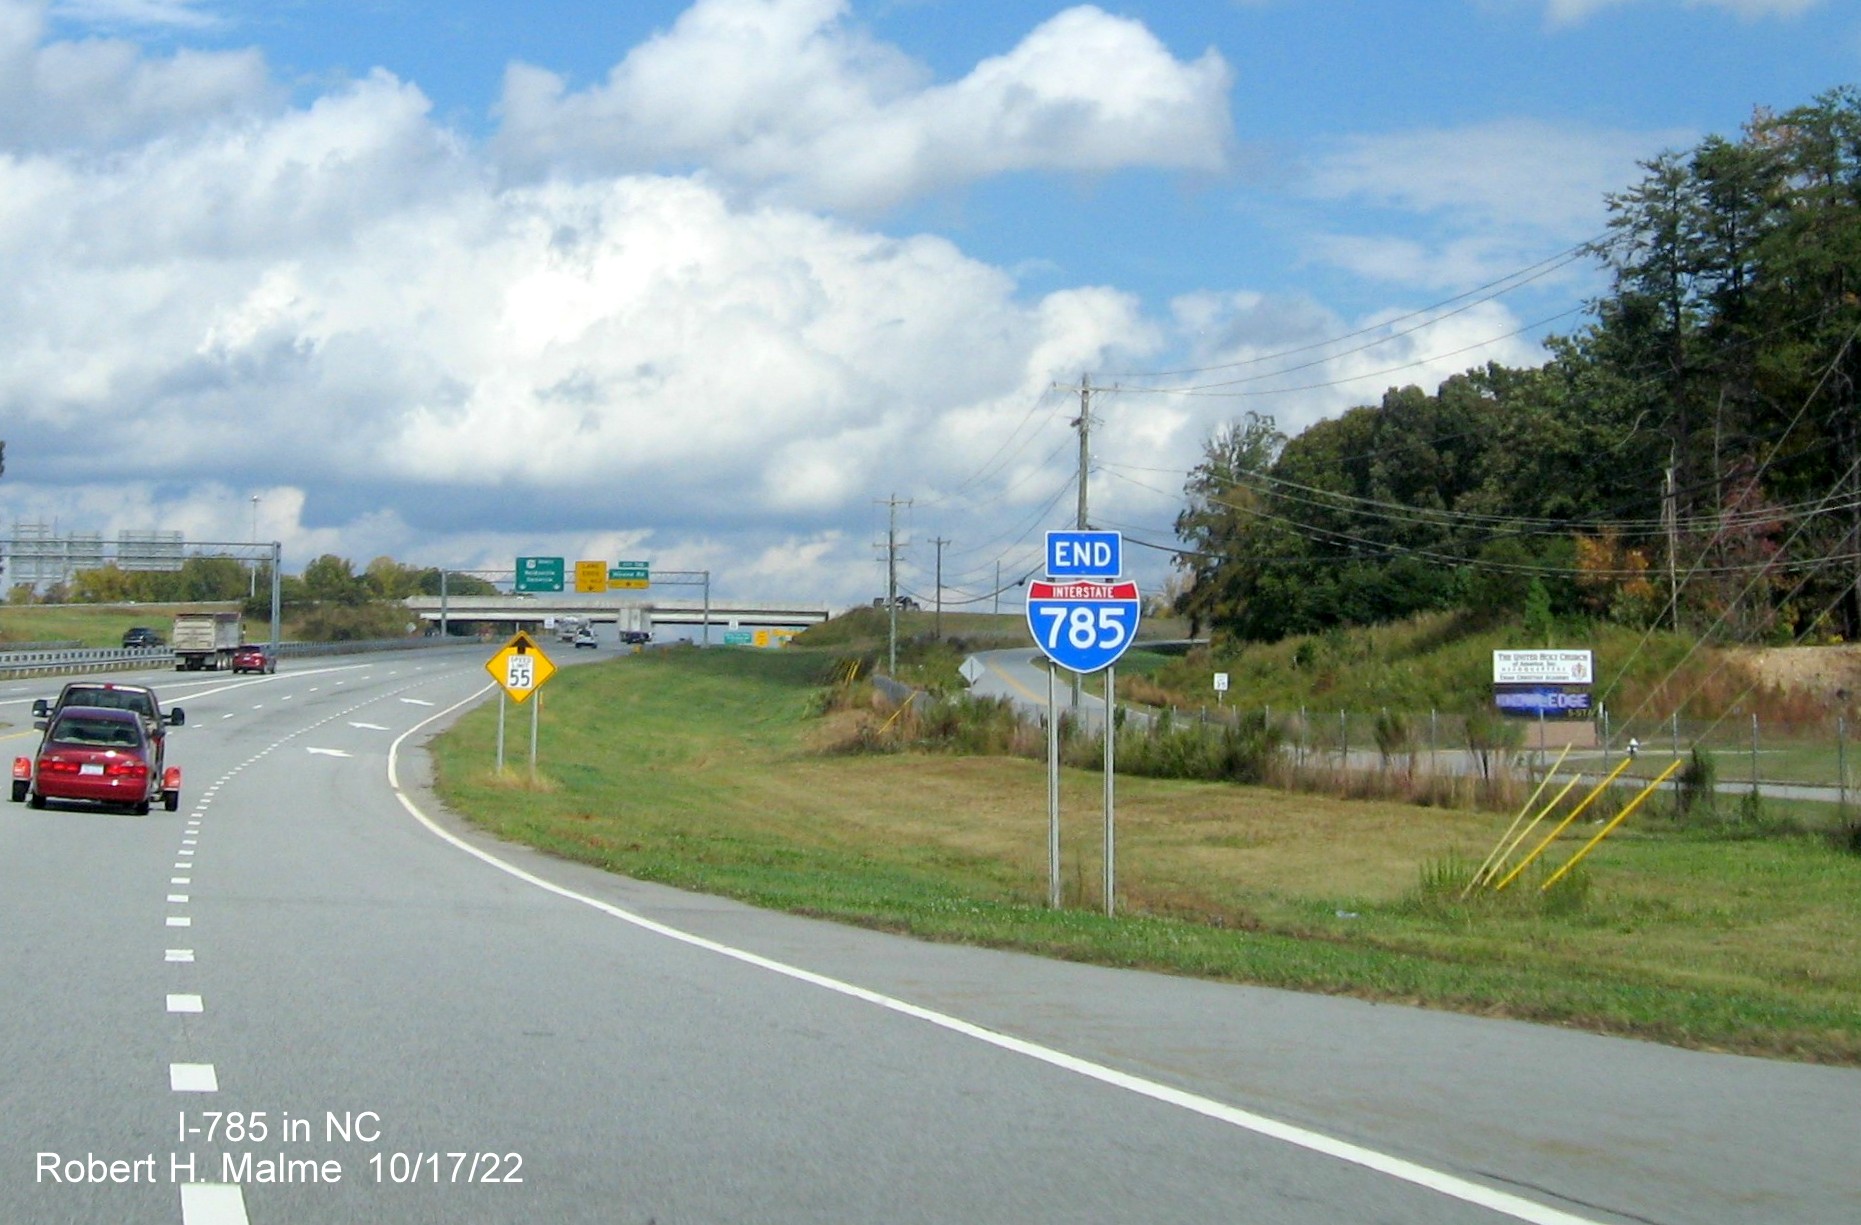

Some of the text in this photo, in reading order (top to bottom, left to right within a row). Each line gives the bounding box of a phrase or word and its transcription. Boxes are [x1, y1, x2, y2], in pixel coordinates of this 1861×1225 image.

[1055, 541, 1112, 567] END
[1052, 586, 1115, 598] INTERSTATE
[1040, 607, 1125, 649] 785
[510, 669, 530, 687] 55
